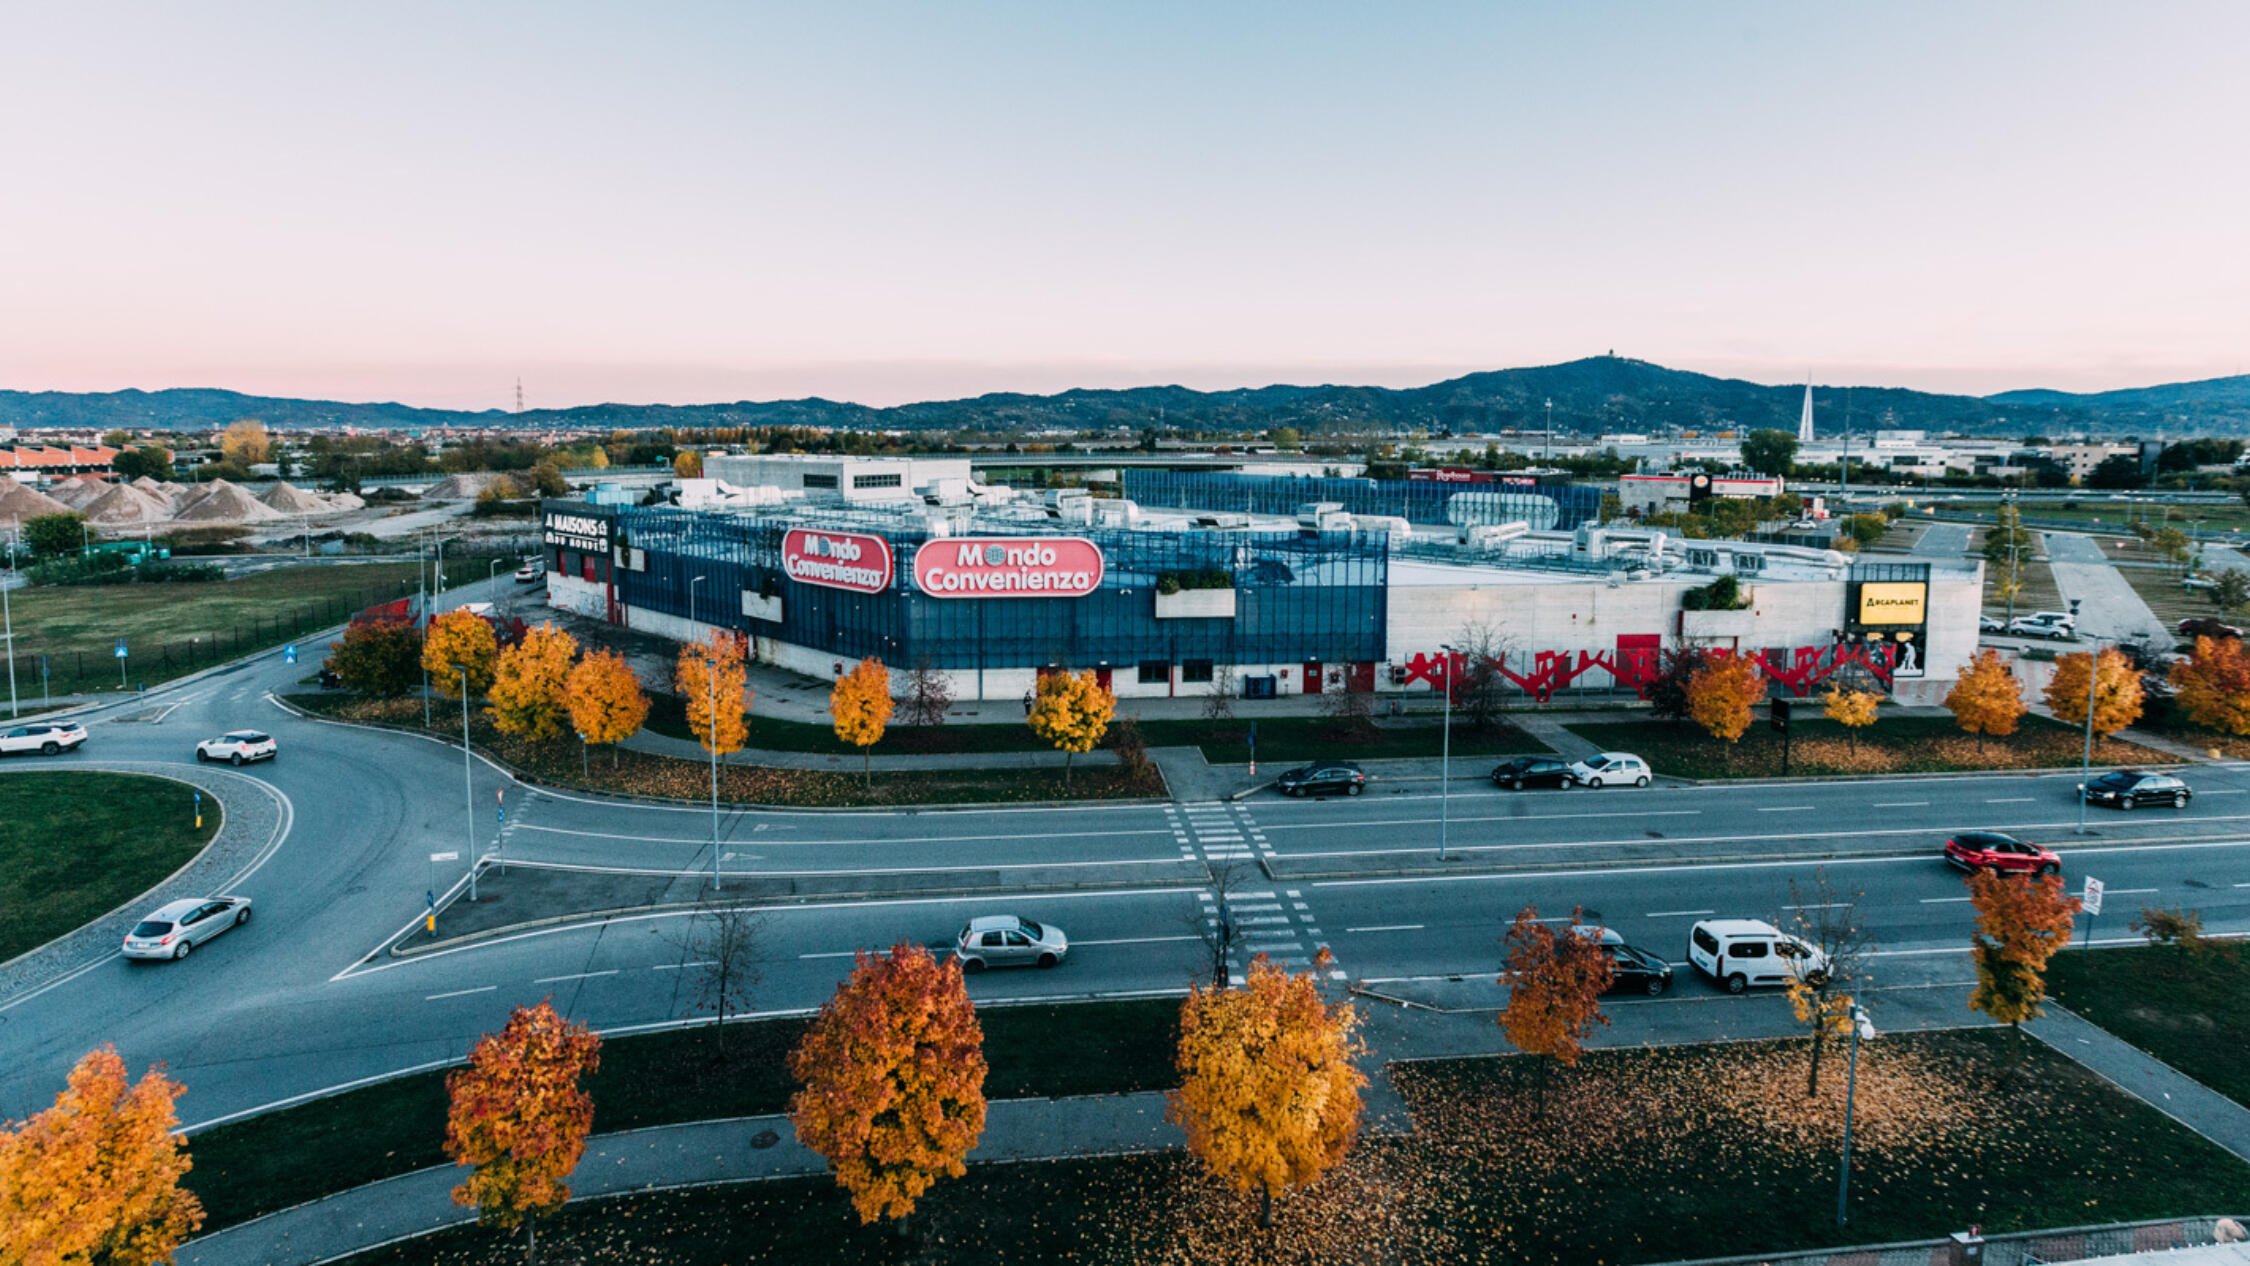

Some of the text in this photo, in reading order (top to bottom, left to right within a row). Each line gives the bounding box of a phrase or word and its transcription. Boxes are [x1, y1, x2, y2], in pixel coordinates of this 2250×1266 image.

[554, 514, 598, 535] MAISONS
[803, 534, 861, 561] Mondo
[957, 542, 1056, 567] Mondo
[788, 553, 881, 587] Convenienza
[925, 566, 1089, 591] Convenienza
